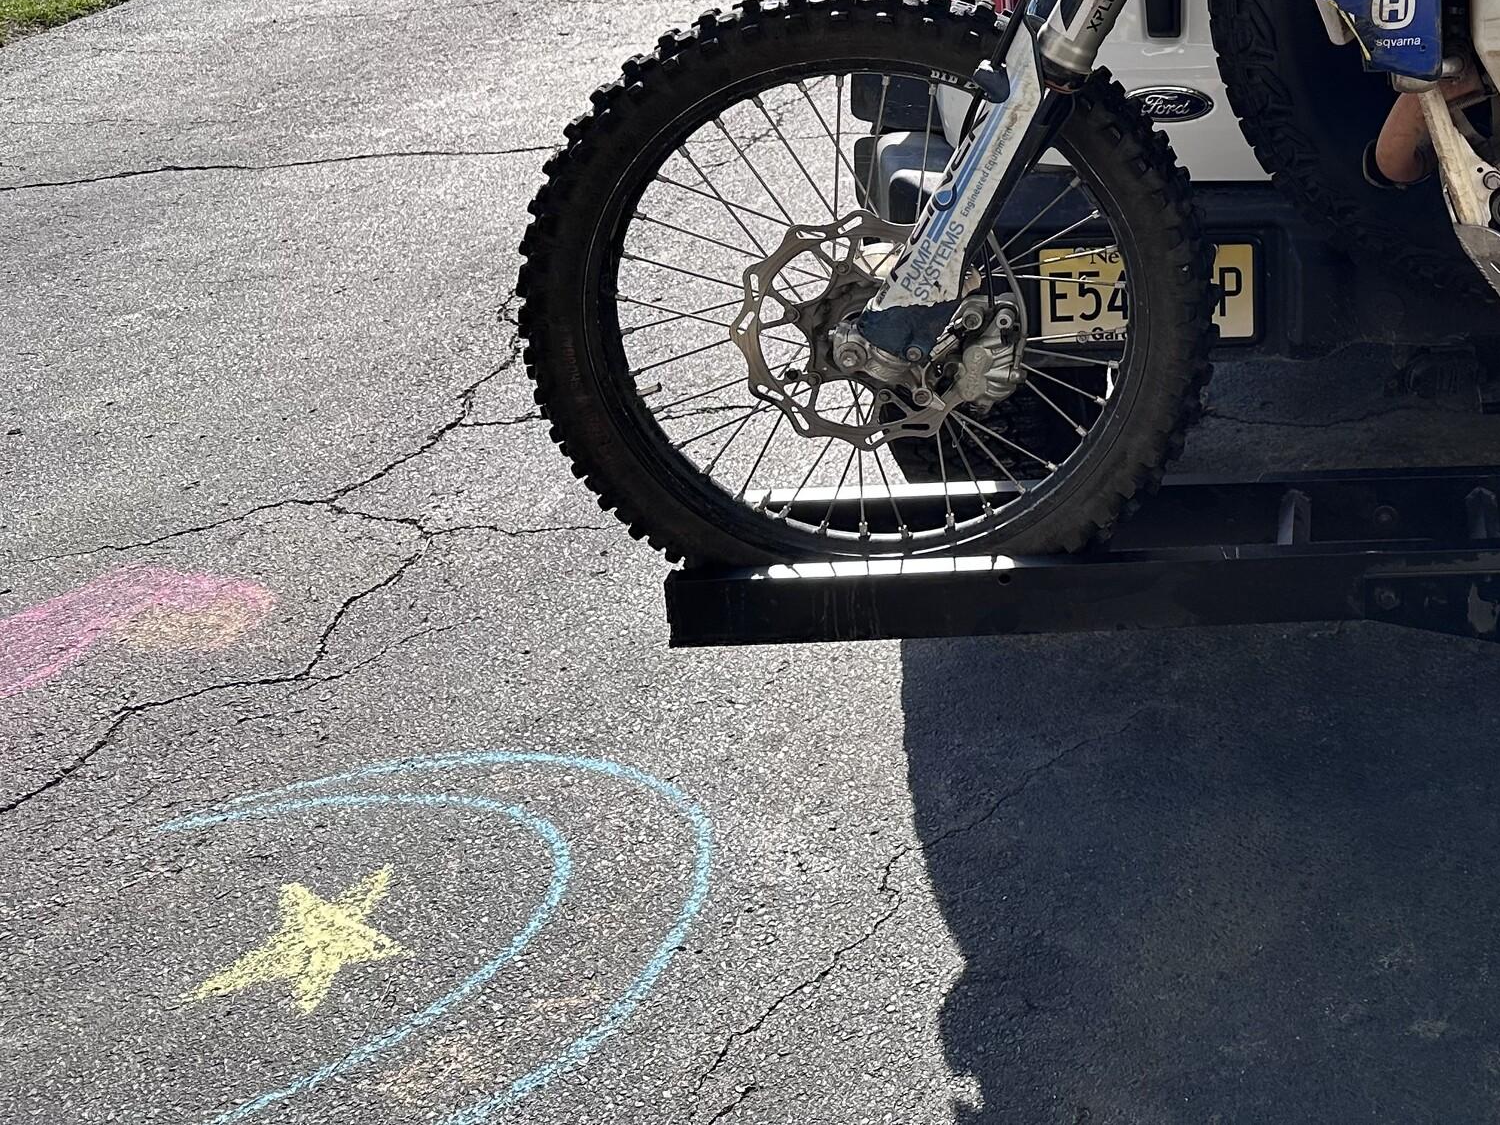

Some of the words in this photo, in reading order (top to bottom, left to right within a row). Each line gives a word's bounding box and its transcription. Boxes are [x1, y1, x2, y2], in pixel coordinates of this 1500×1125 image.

[1375, 37, 1421, 49] sqvarna
[1140, 94, 1191, 116] Ford
[960, 170, 990, 218] Engineered
[900, 238, 934, 293] PUMP
[914, 220, 965, 301] SYSTEMS
[1089, 248, 1120, 265] Ne
[1048, 269, 1129, 323] E54
